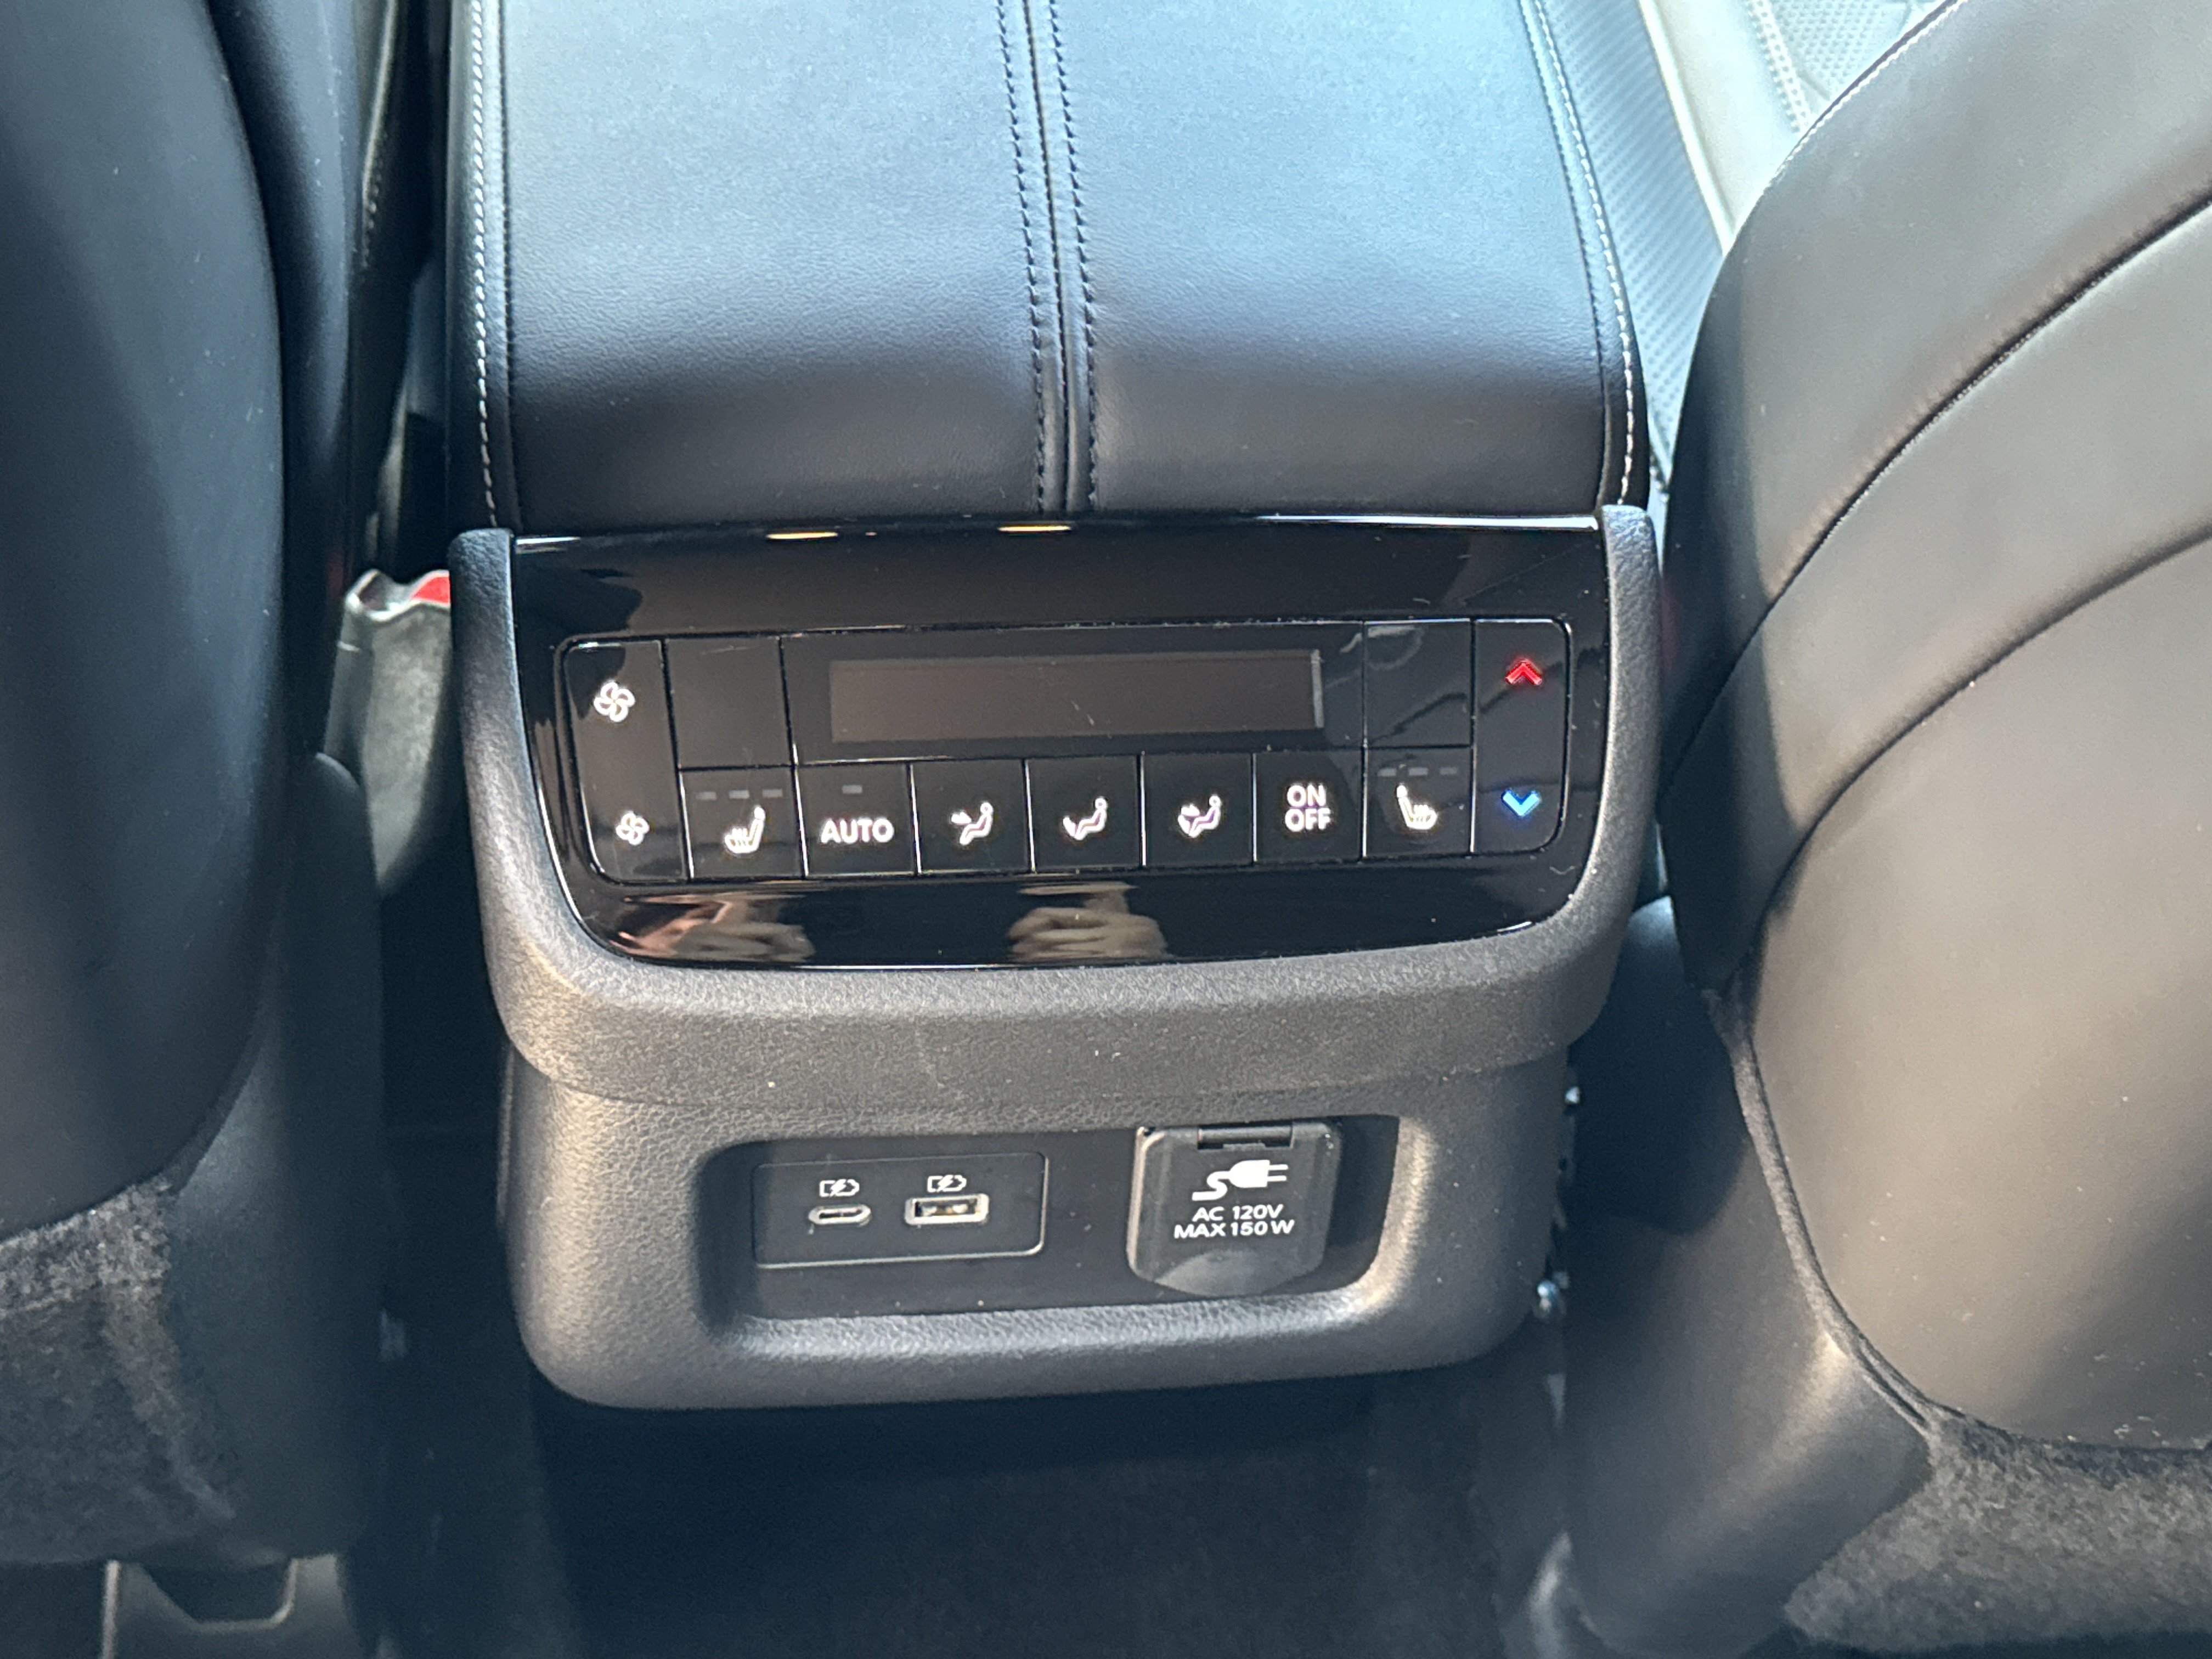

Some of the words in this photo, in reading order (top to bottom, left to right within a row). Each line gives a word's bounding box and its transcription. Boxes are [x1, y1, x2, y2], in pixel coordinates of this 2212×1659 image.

[1286, 783, 1327, 806] ON
[819, 816, 894, 844] AUTO
[1284, 807, 1331, 832] OFF
[1192, 1206, 1224, 1222] AC
[1232, 1204, 1284, 1220] 120V
[1173, 1222, 1226, 1239] MAX
